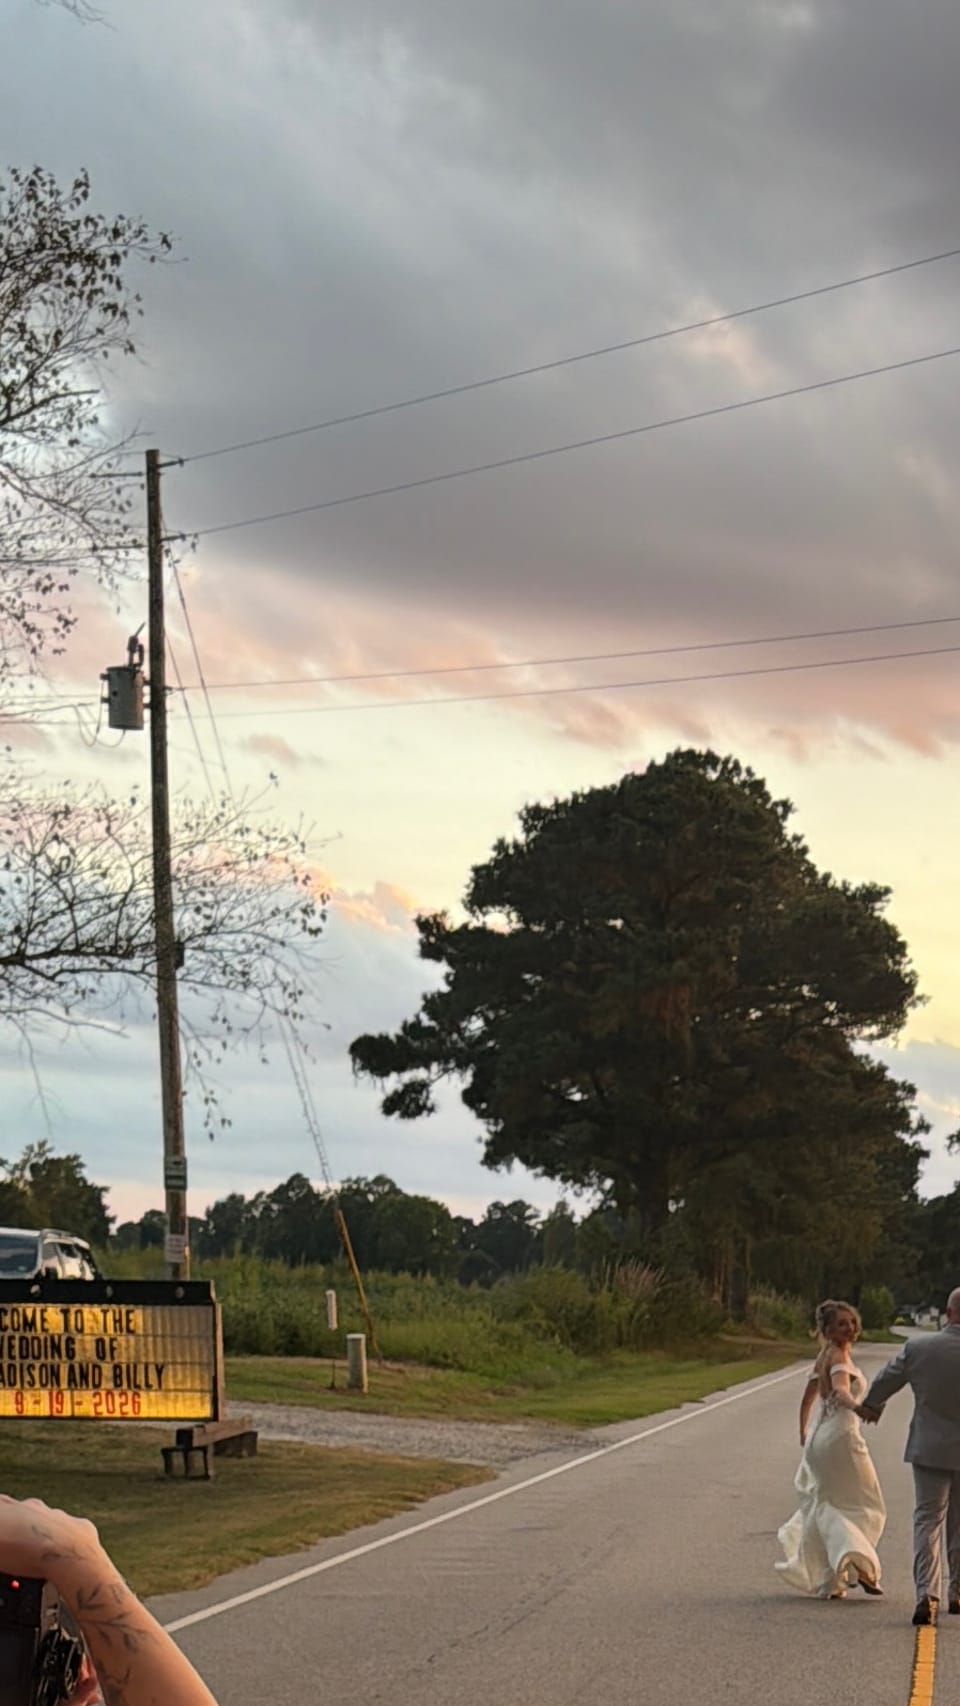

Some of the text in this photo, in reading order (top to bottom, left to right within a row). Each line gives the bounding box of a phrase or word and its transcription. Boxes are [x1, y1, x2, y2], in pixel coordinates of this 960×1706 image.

[60, 1309, 84, 1333] TO
[101, 1309, 136, 1333] THE
[95, 1337, 118, 1360] OF
[68, 1364, 102, 1389] AND
[113, 1365, 165, 1390] BILLY
